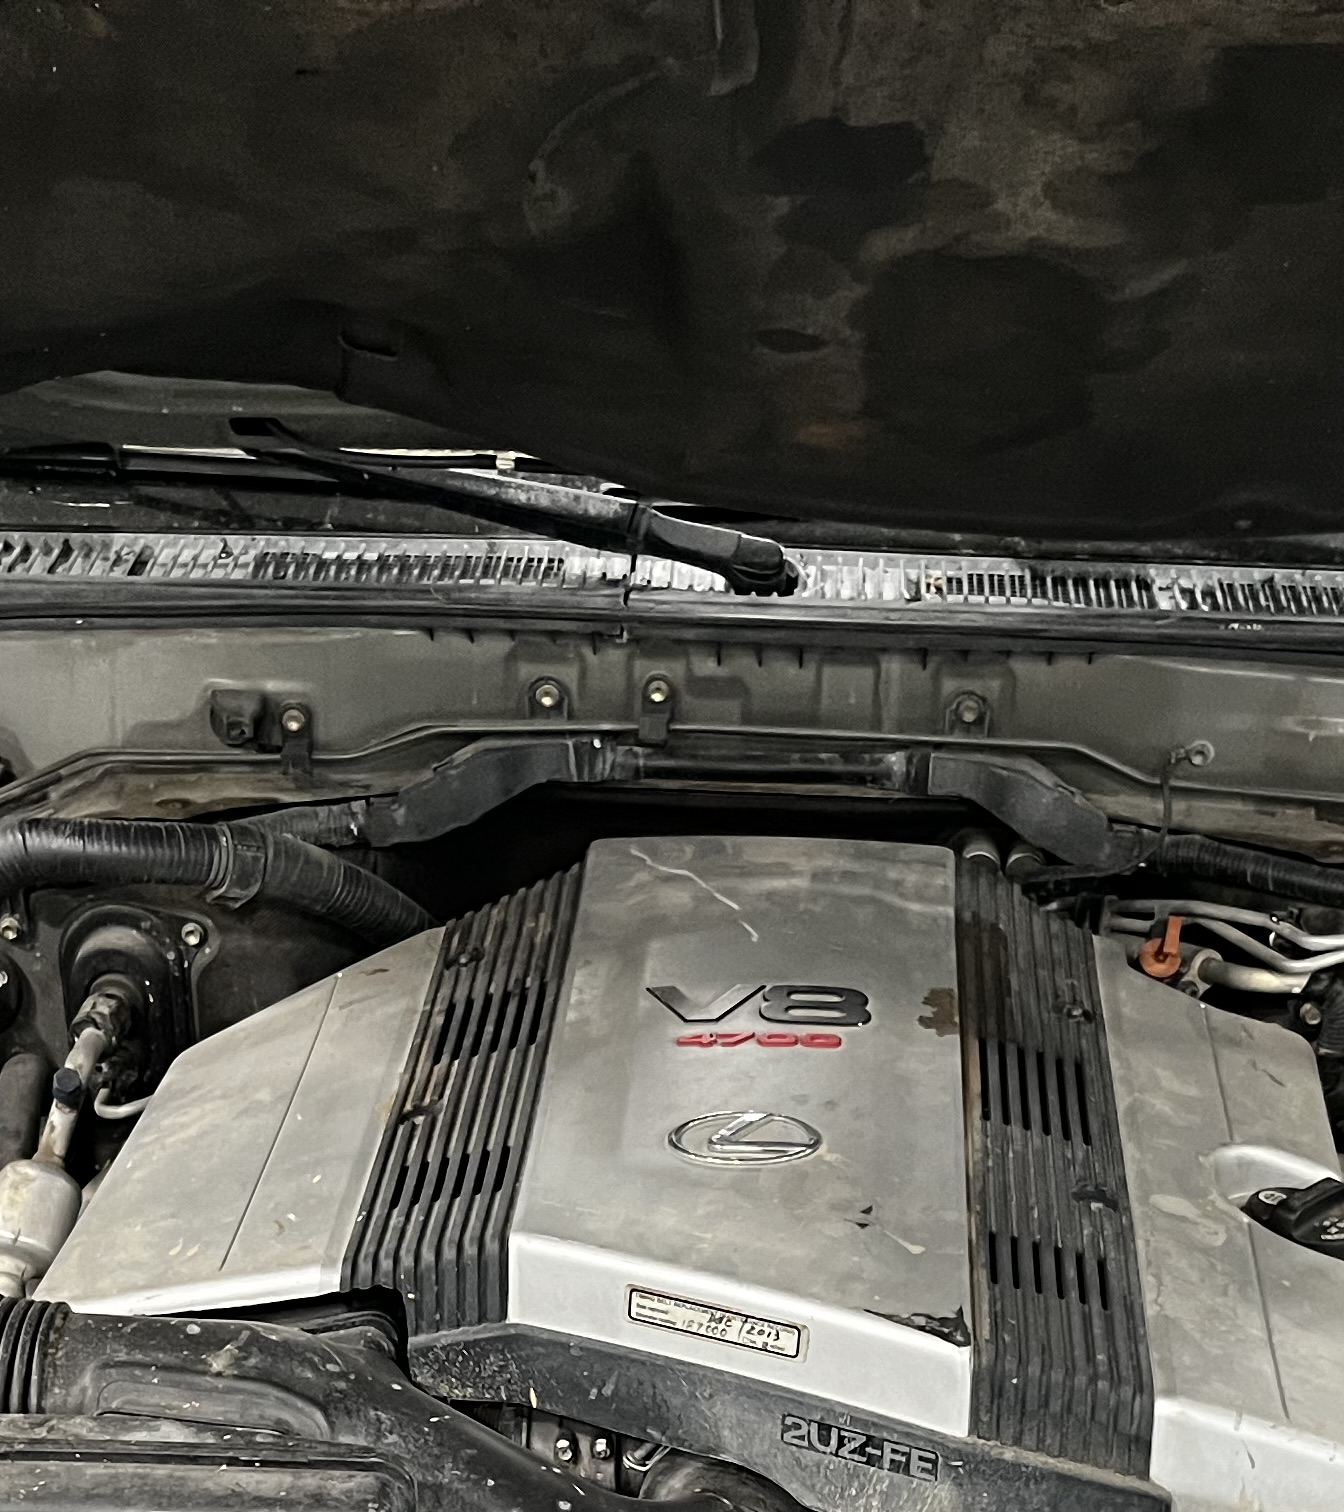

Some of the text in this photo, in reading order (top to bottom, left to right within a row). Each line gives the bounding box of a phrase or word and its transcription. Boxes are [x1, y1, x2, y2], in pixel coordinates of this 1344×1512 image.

[645, 983, 873, 1027] V8
[674, 1030, 844, 1049] 4700
[746, 1325, 780, 1342] 2013
[782, 1414, 939, 1482] 2UZ-FE
